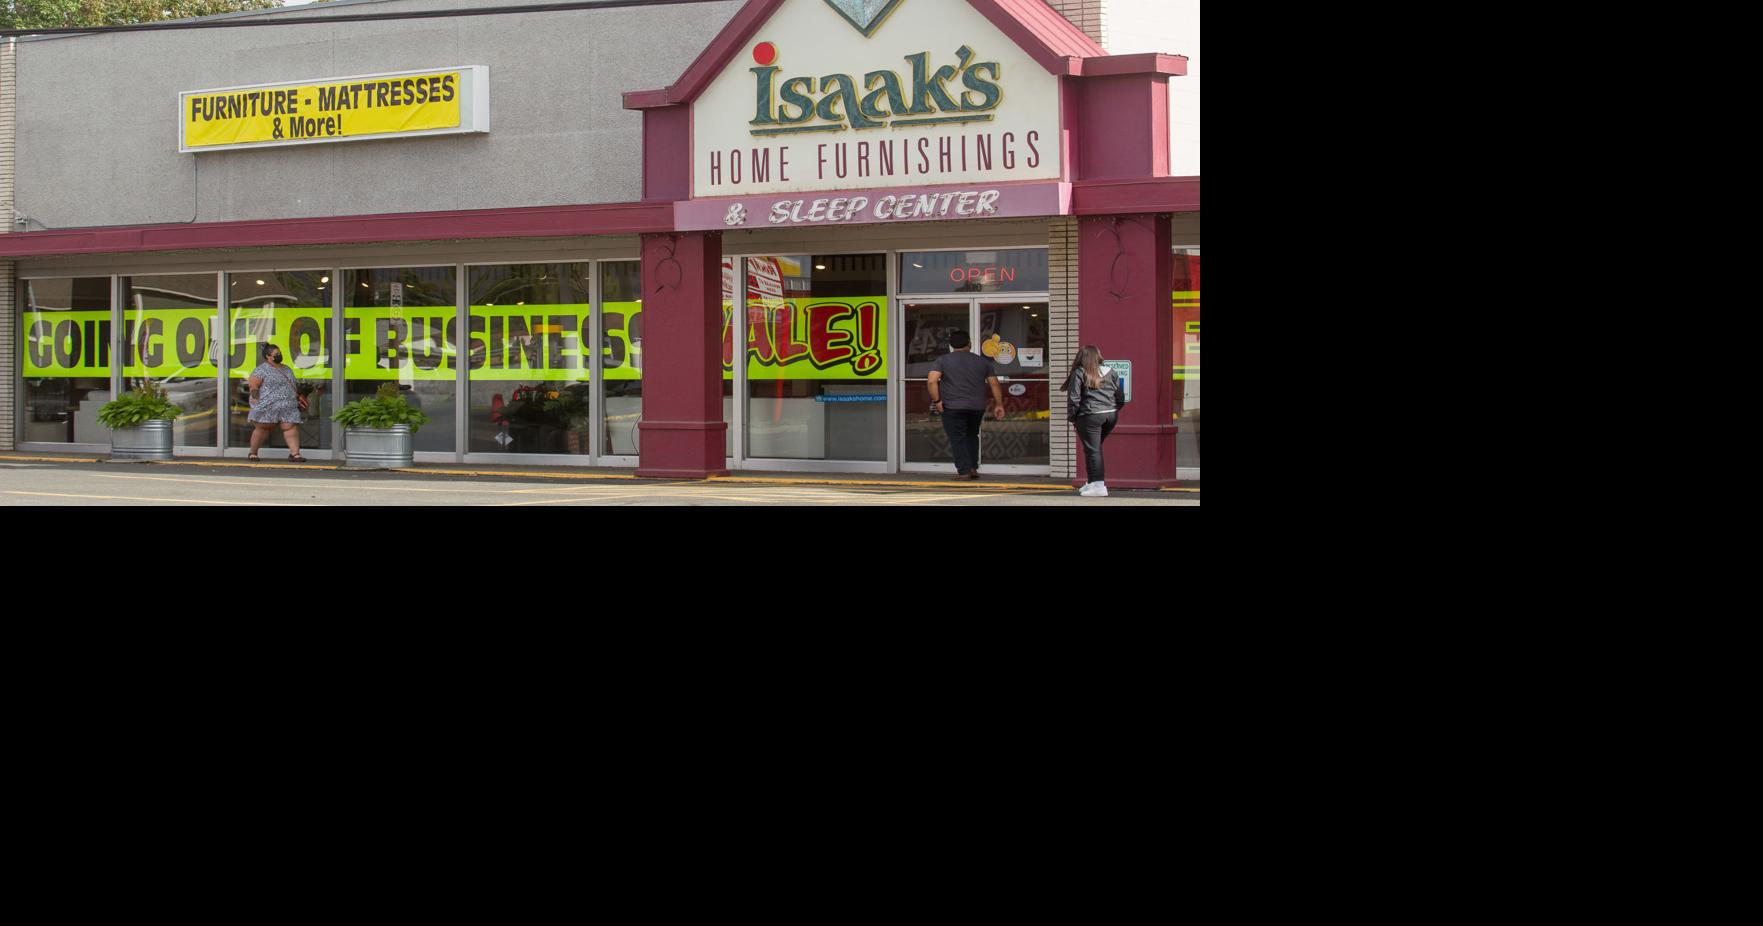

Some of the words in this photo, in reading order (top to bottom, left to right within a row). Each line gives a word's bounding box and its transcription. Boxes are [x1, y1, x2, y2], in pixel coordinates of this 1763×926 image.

[191, 89, 298, 122] FURNITURE
[305, 98, 312, 106] -
[318, 75, 455, 112] MATTRESSES
[272, 113, 284, 139] &
[289, 113, 343, 138] More!
[710, 146, 791, 186] HOME
[817, 130, 1040, 180] FURNISHINGS
[724, 202, 748, 226] &
[768, 195, 868, 224] SLEEP
[873, 189, 1000, 219] CENTER
[949, 265, 1016, 283] OPEN
[28, 318, 165, 369] GOING
[176, 316, 277, 369] OUT
[289, 316, 361, 370] OF
[722, 302, 882, 376] ALE!
